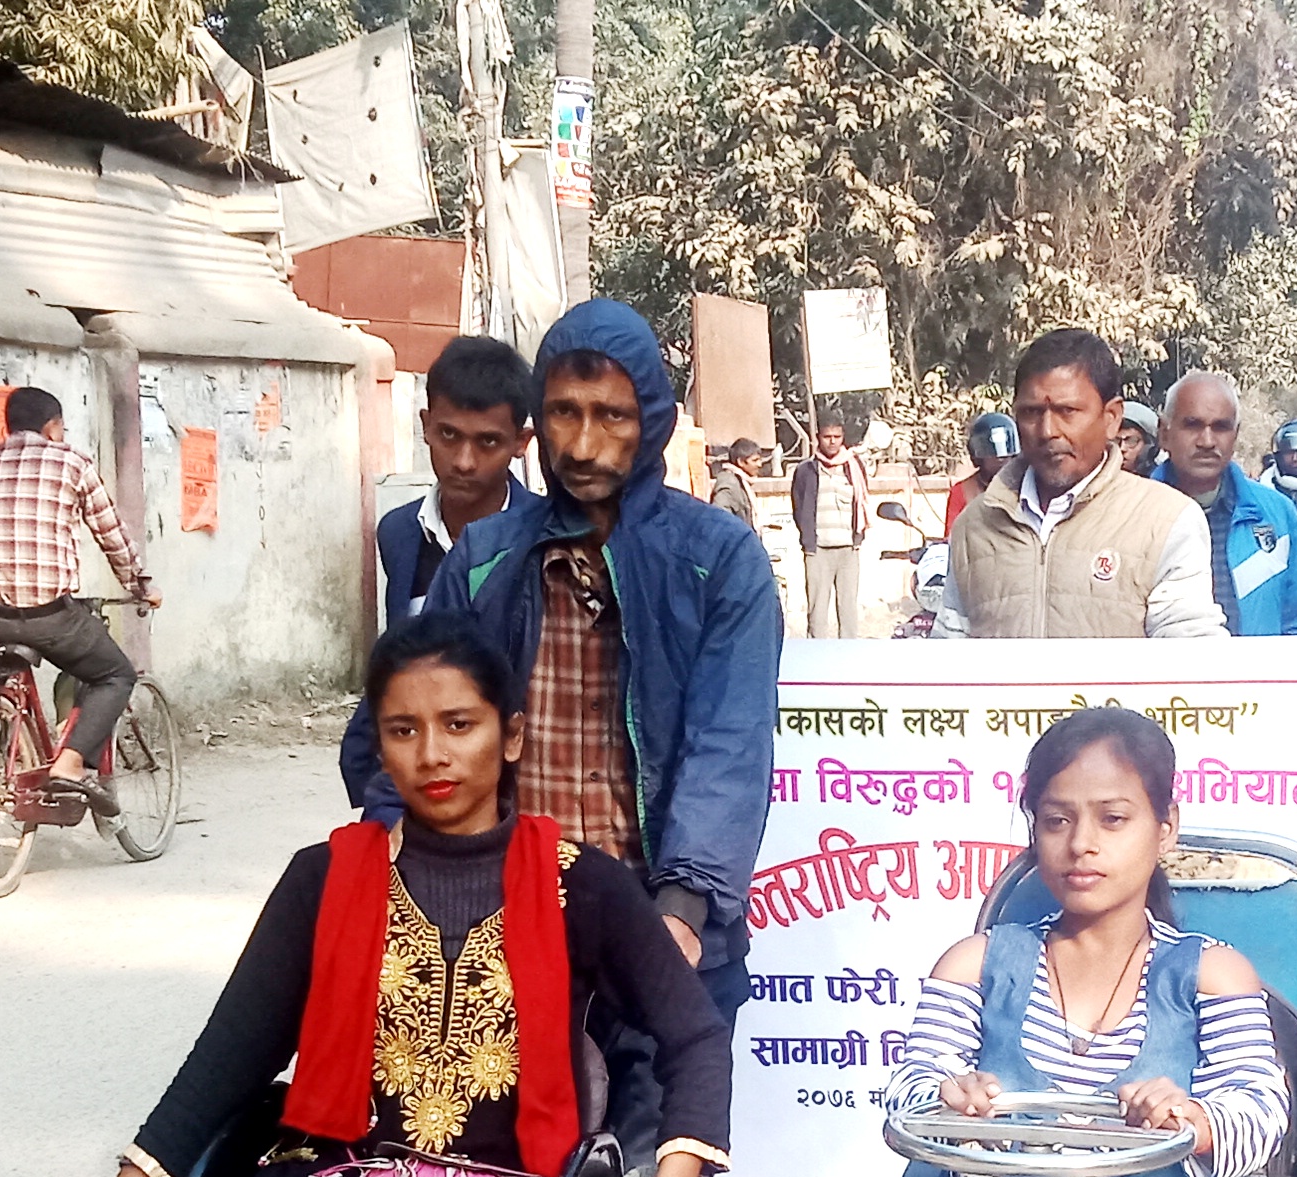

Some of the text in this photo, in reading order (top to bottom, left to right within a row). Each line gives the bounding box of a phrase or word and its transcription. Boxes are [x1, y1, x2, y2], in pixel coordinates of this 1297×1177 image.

[902, 708, 970, 738] लक्ष्य
[750, 974, 814, 1004] भात
[797, 1088, 856, 1109] २०७६
